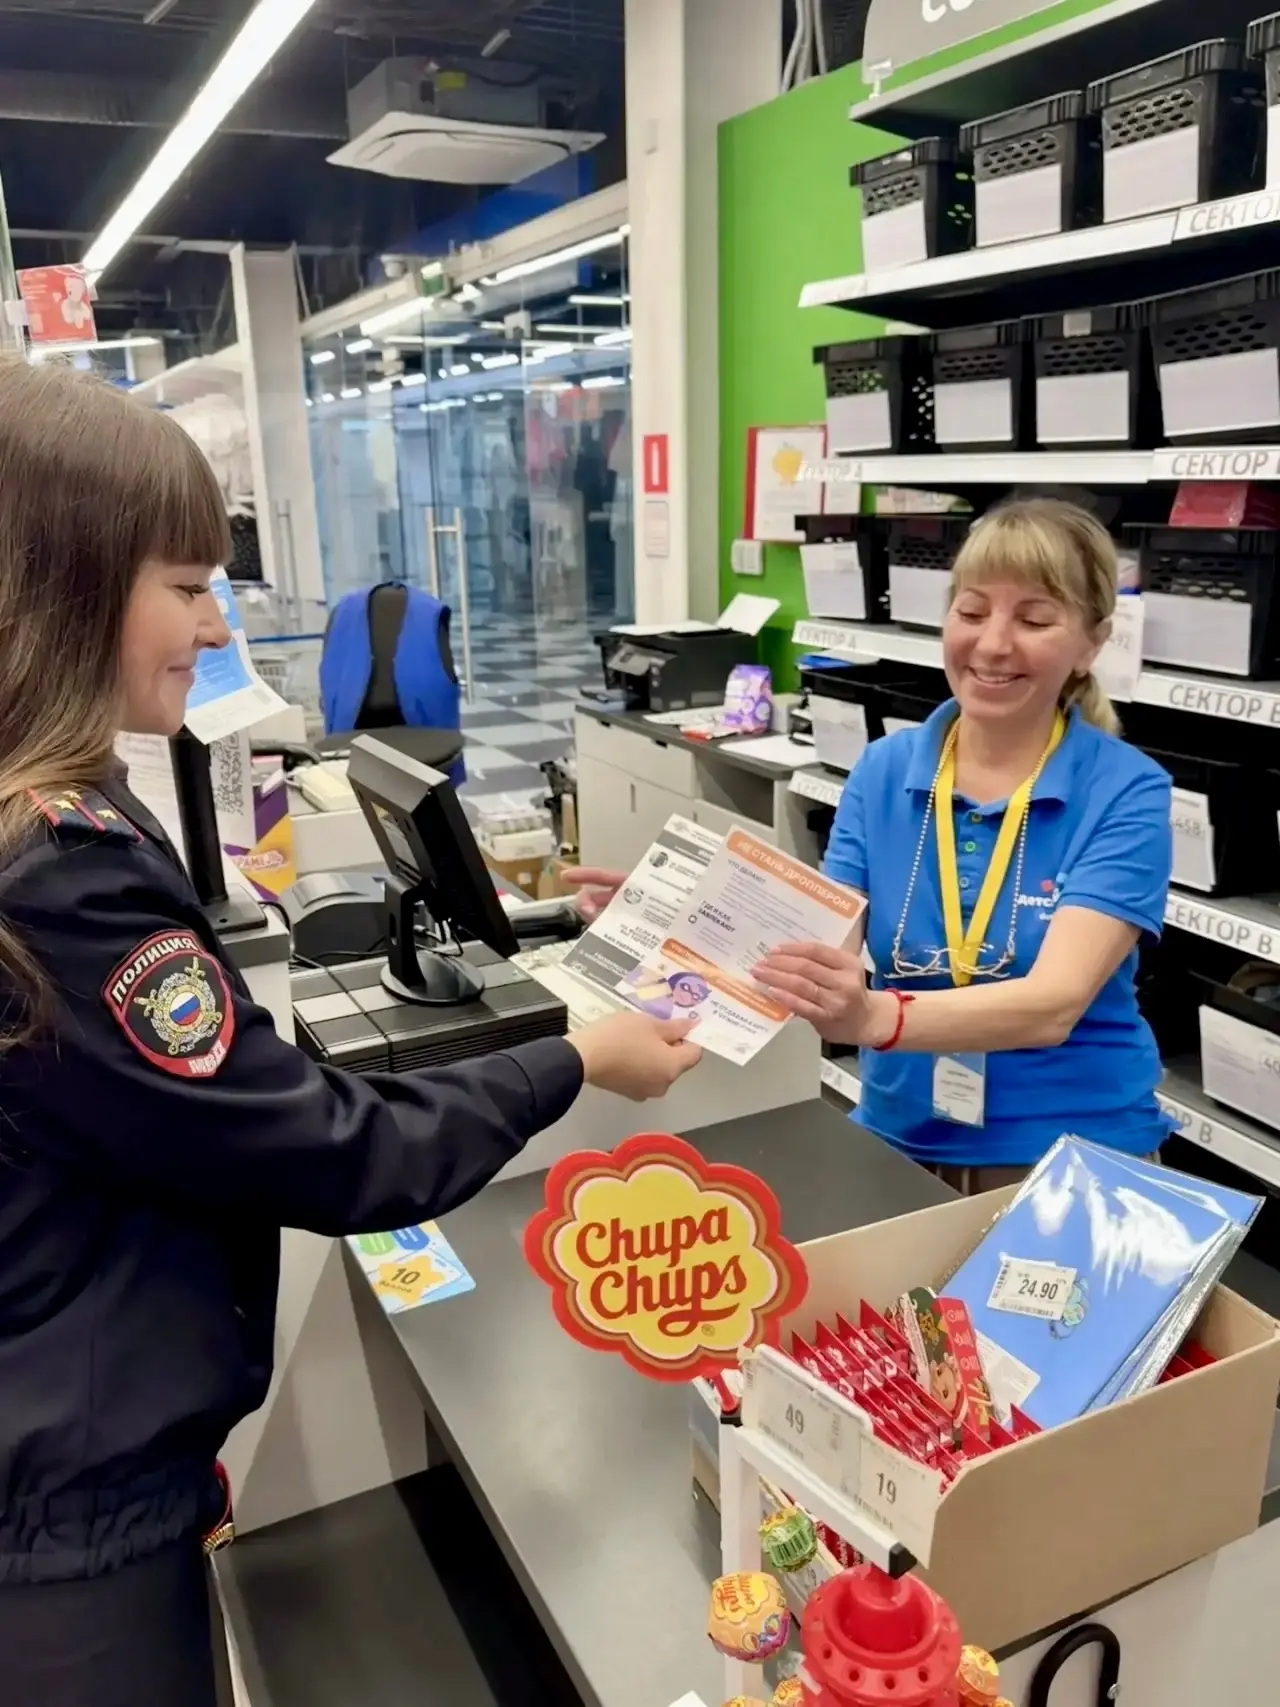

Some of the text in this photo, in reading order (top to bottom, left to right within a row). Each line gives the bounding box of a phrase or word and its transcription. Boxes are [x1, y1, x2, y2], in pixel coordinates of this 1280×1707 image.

[1171, 452, 1269, 476] СЕКТОР
[1168, 684, 1263, 719] СЕКТОР
[1257, 933, 1273, 955] В
[111, 937, 199, 1004] ПОЛИЦИЯ
[188, 1039, 227, 1074] МВД
[575, 1206, 732, 1269] Chupa
[391, 1267, 421, 1285] 10
[1018, 1278, 1059, 1300] 24.90
[590, 1255, 747, 1337] Chups
[785, 1403, 804, 1434] 49
[877, 1472, 897, 1504] 19
